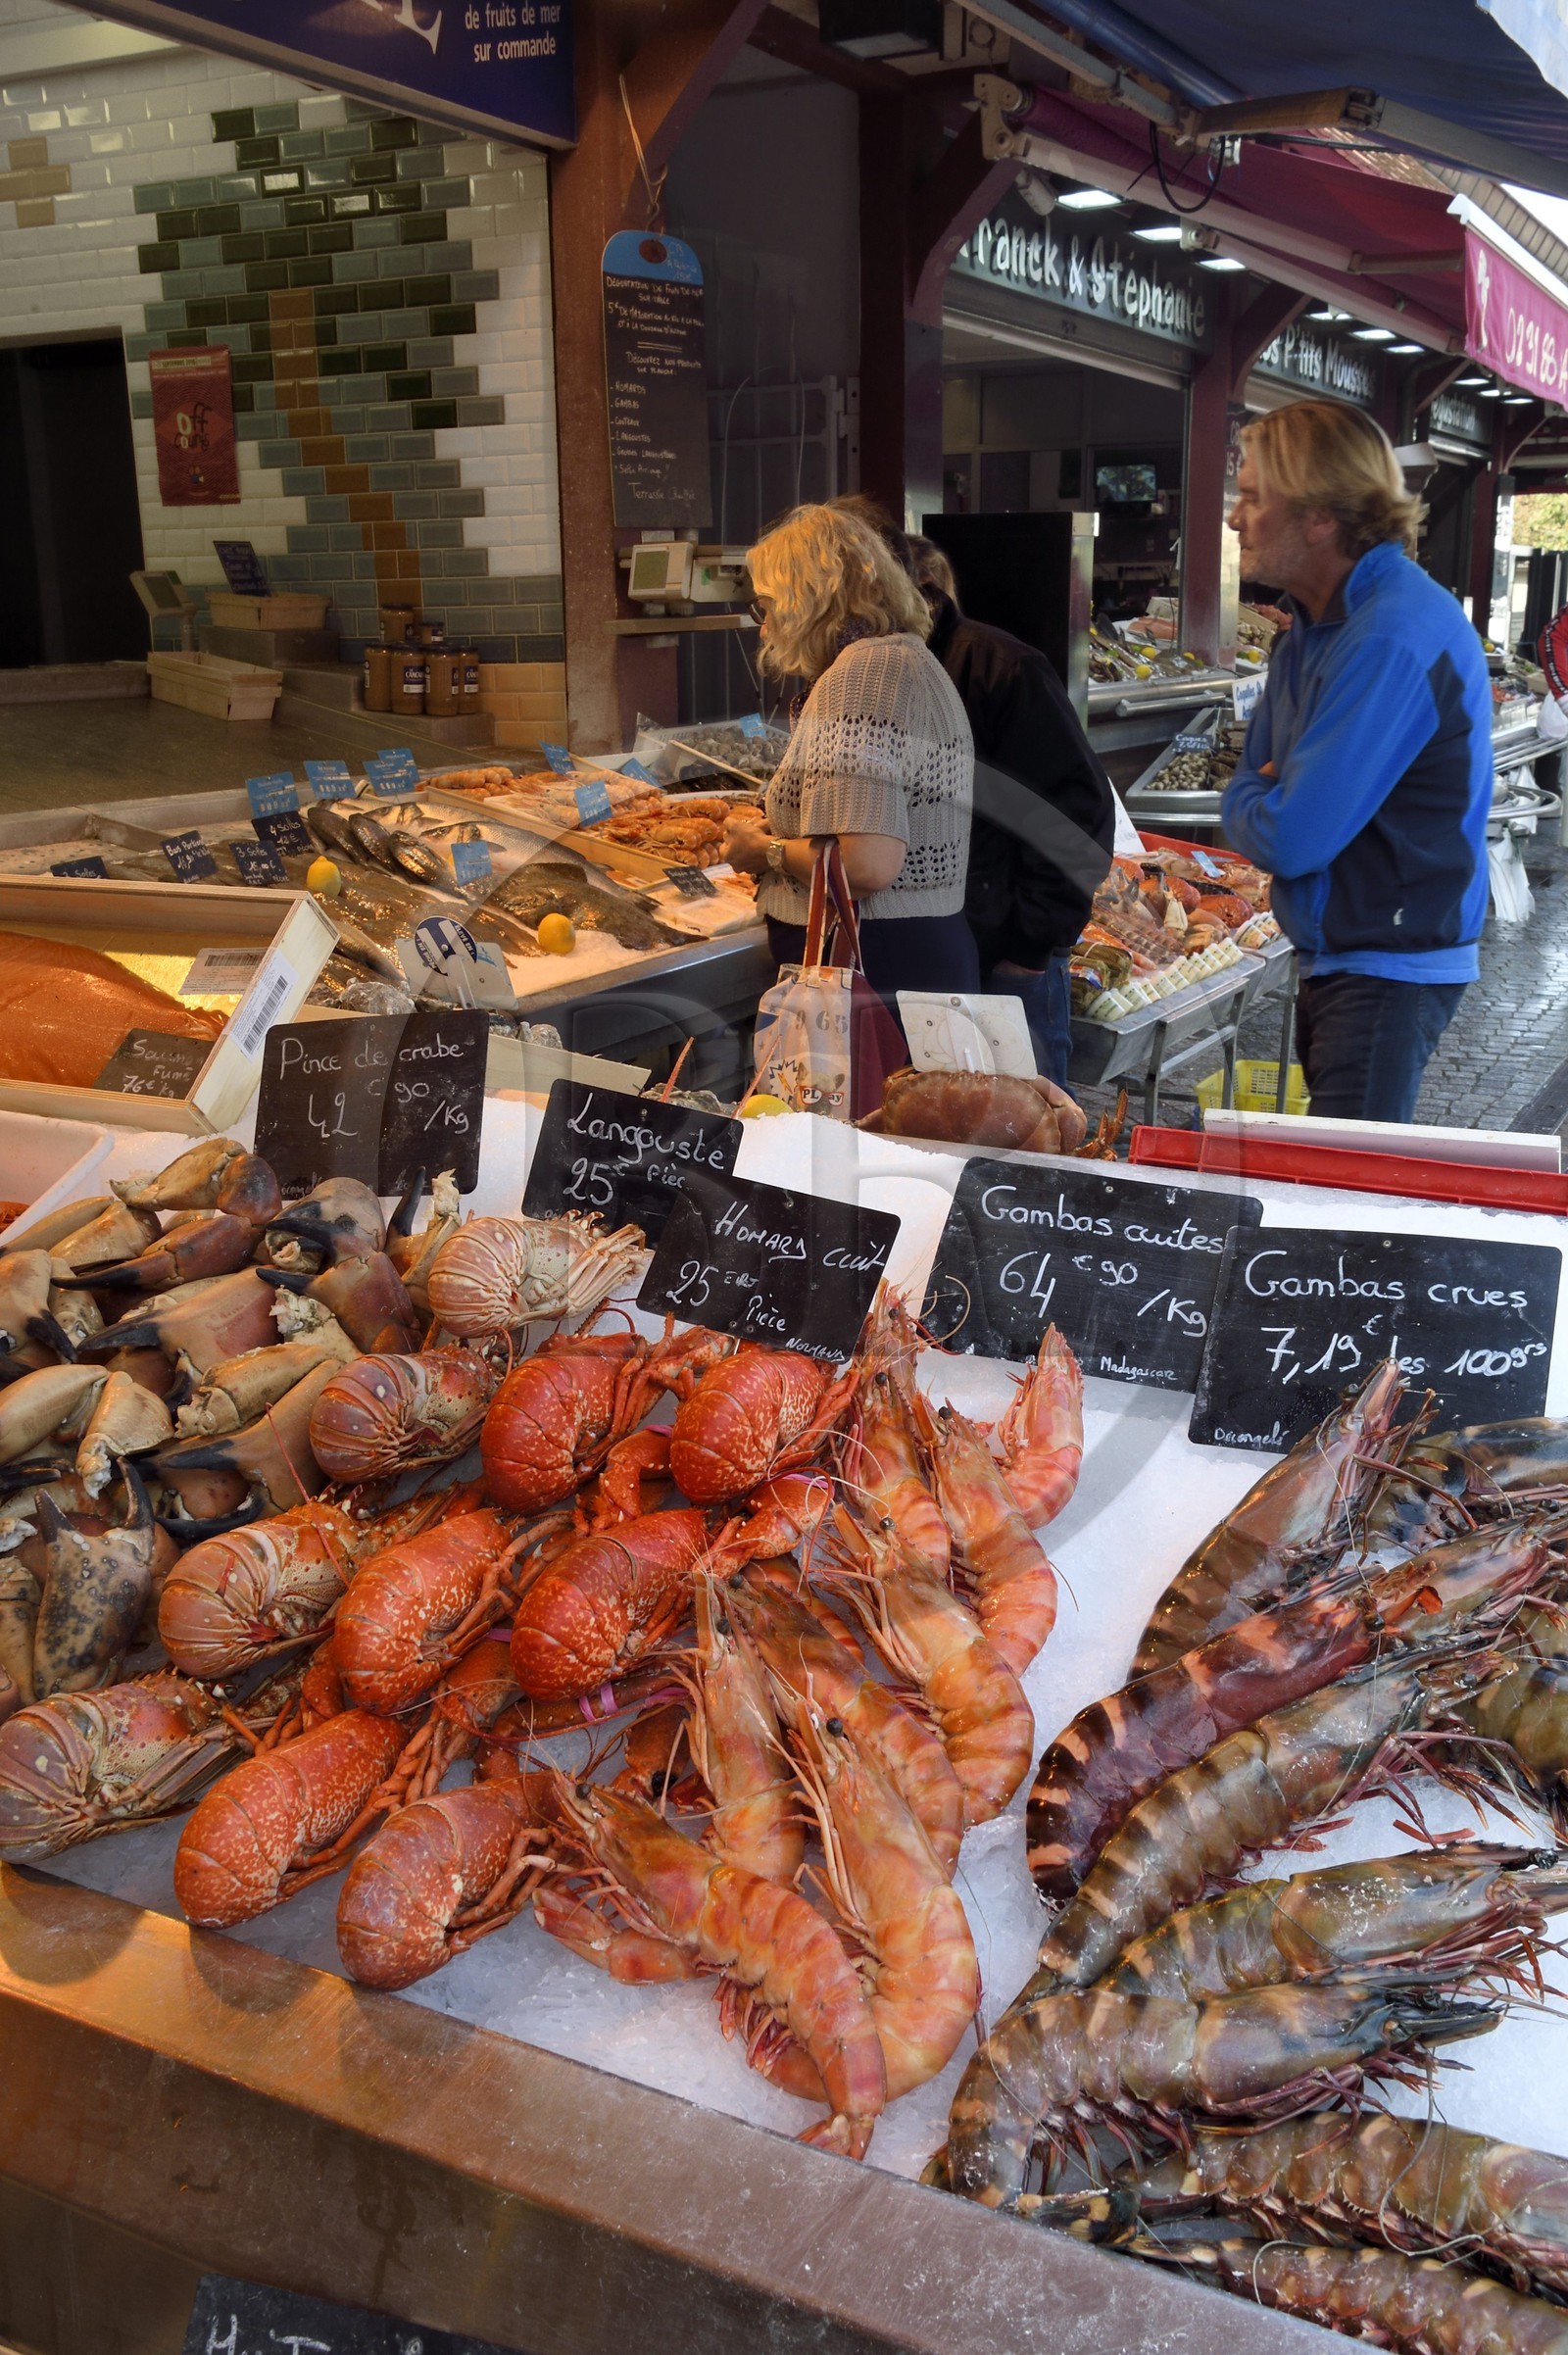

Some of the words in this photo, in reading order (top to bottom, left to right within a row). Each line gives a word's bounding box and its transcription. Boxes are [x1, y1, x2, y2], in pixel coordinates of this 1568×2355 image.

[465, 5, 480, 30] de
[485, 5, 516, 29] fruits
[521, 1, 536, 25] de
[540, 4, 562, 25] mer
[473, 43, 491, 63] sur
[497, 31, 557, 61] commande
[959, 215, 1060, 287] ranck
[1068, 234, 1085, 297] &
[1090, 235, 1206, 338] Stéphanie
[614, 397, 640, 410] GAMBAS
[280, 1037, 342, 1080] Pince
[354, 1041, 388, 1068] de
[399, 1032, 465, 1062] crabe
[566, 1092, 725, 1170] Langouste
[981, 1185, 1114, 1237] Gambas
[1123, 1217, 1225, 1255] cuites
[665, 1260, 719, 1307] 25
[999, 1251, 1057, 1319] 64
[1098, 1259, 1140, 1287] 90
[1245, 1250, 1406, 1300] Gambas
[1427, 1282, 1529, 1309] crues
